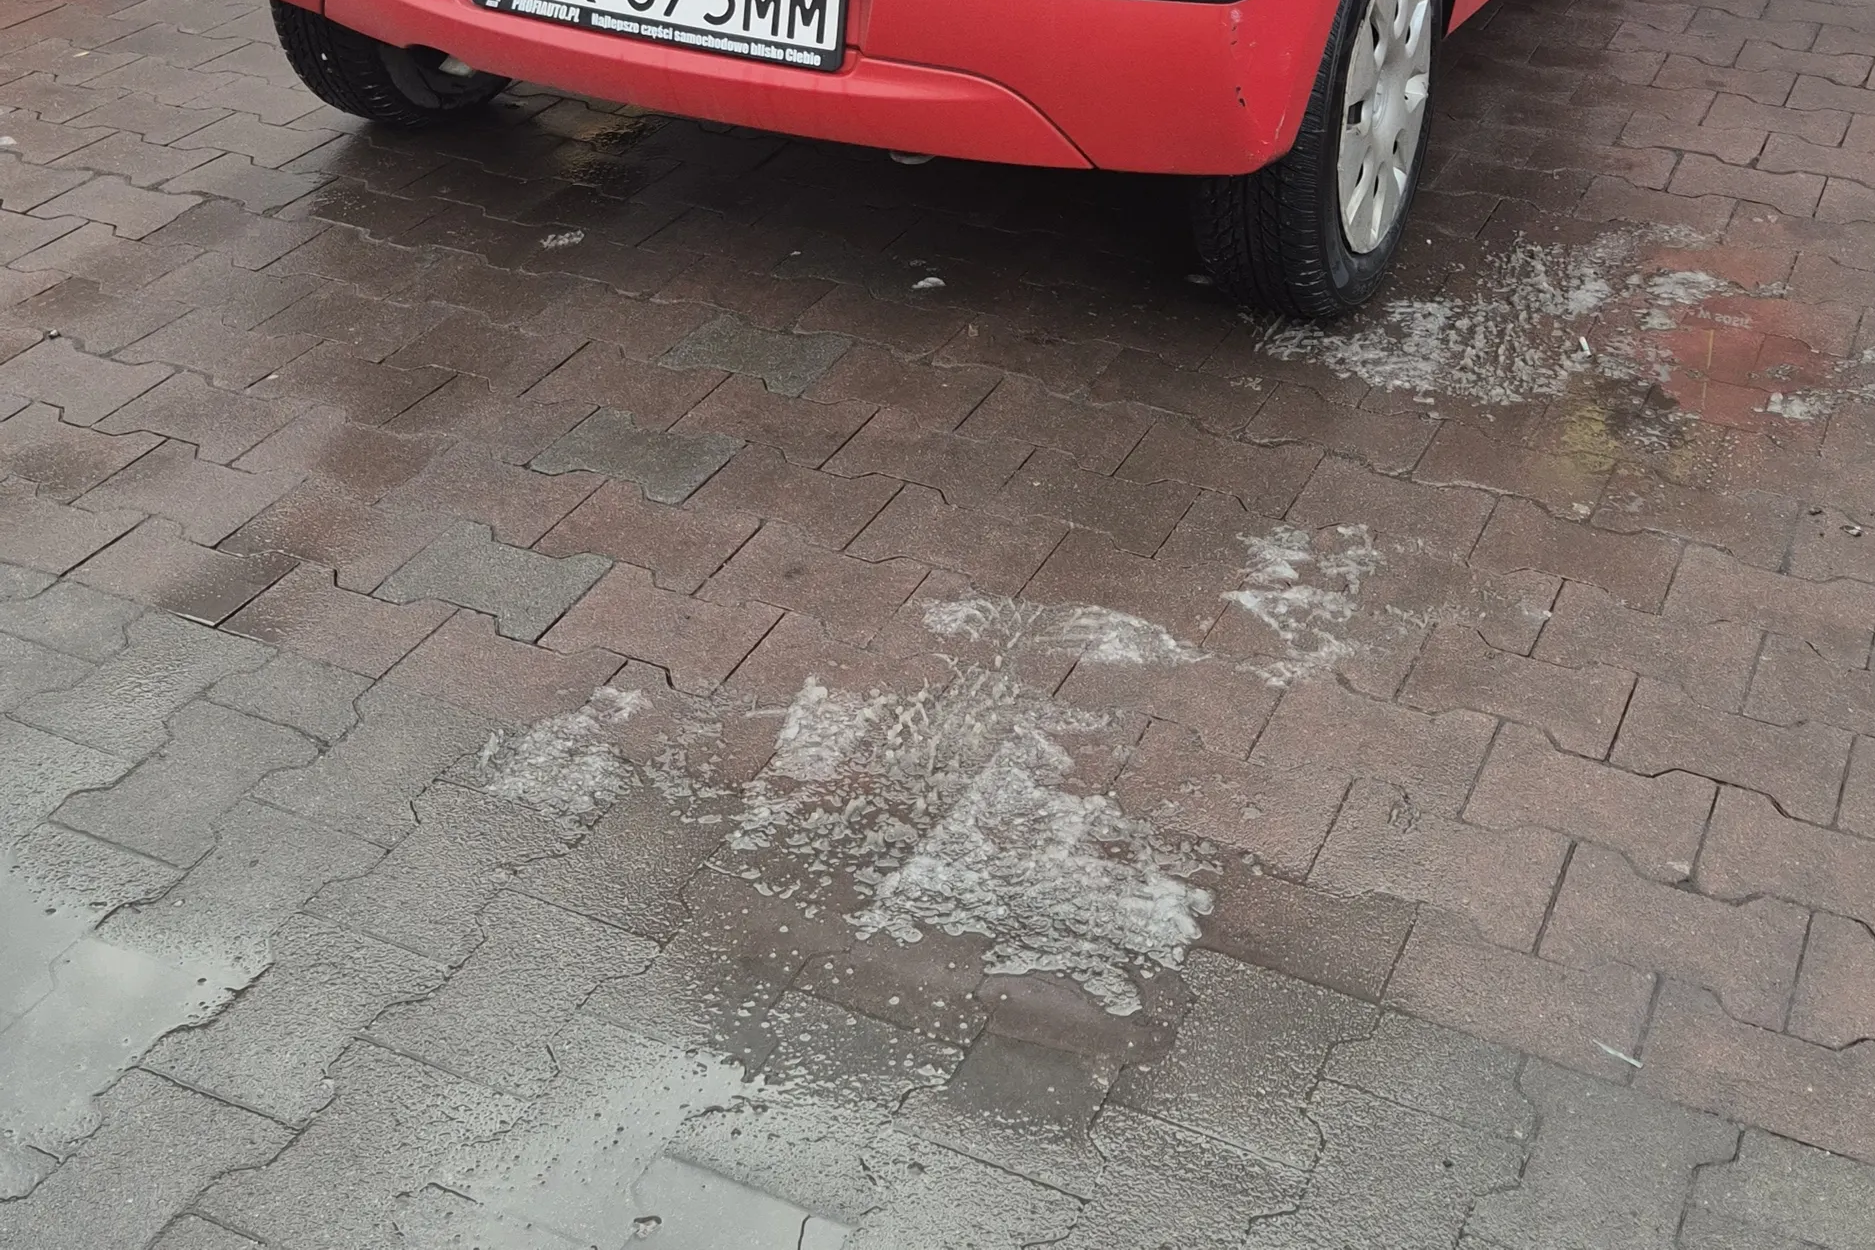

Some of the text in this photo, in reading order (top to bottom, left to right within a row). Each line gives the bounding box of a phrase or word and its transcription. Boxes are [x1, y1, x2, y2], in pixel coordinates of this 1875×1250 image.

[591, 12, 639, 35] Najlepsze
[641, 23, 673, 42] części
[674, 28, 750, 55] samochodowe
[750, 42, 784, 61] blisko
[785, 48, 822, 67] Ciebie
